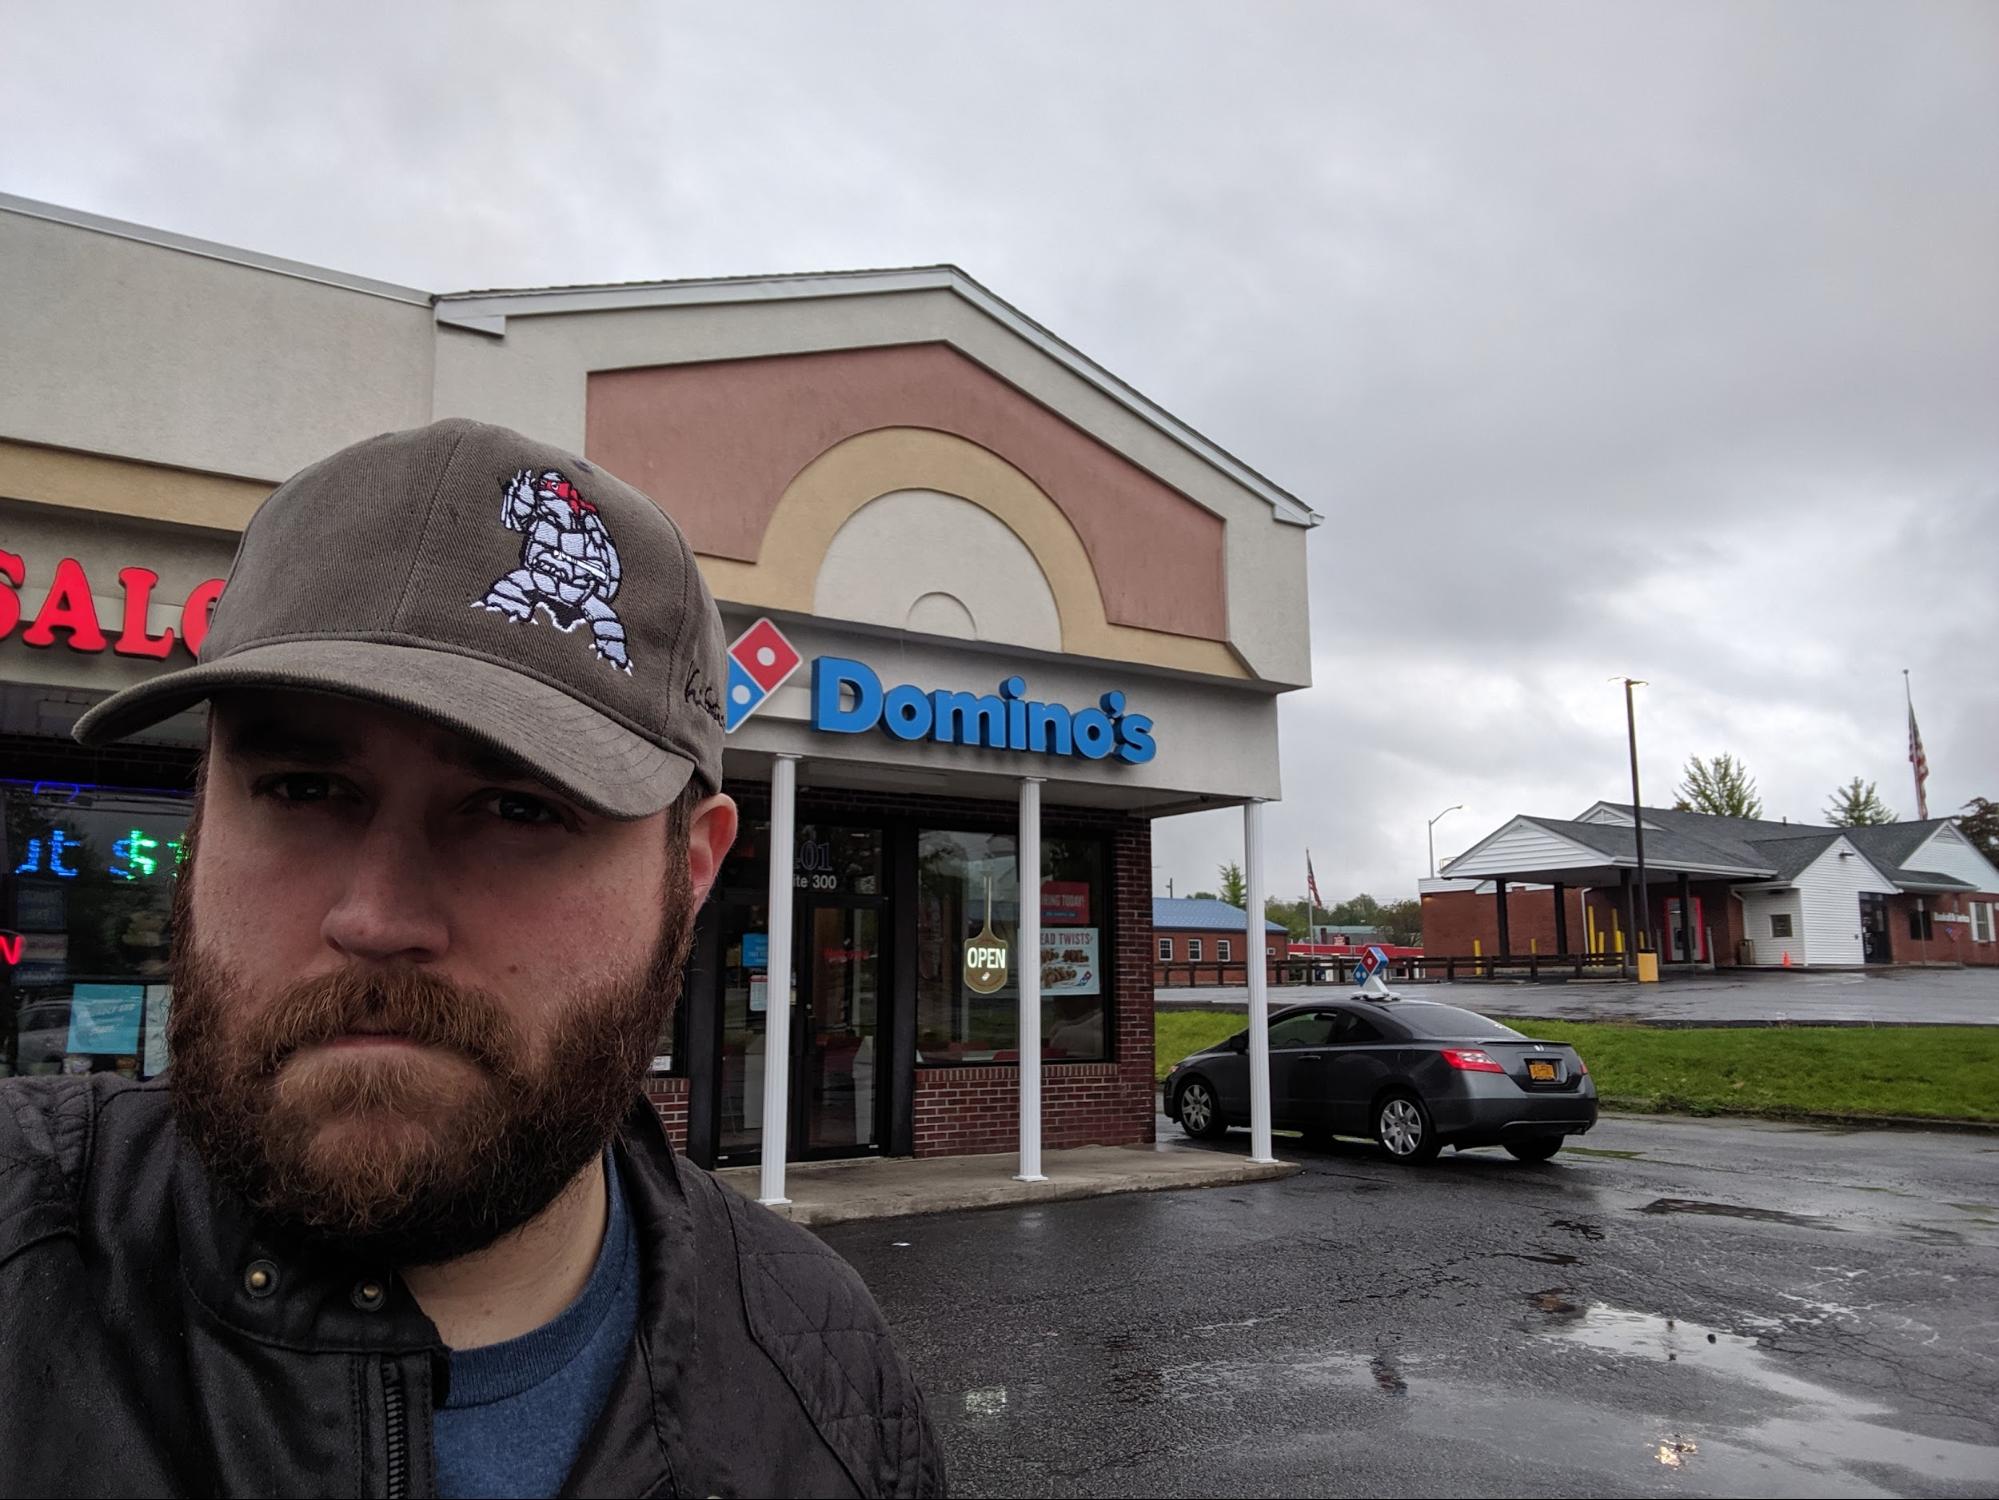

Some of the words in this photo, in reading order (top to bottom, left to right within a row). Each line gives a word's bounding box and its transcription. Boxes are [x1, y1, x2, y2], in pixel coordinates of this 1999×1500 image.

[811, 655, 1157, 764] Domino's
[812, 874, 837, 889] 300
[1040, 932, 1056, 945] EAD
[1059, 932, 1090, 945] TWISTS
[967, 946, 1006, 969] OPEN
